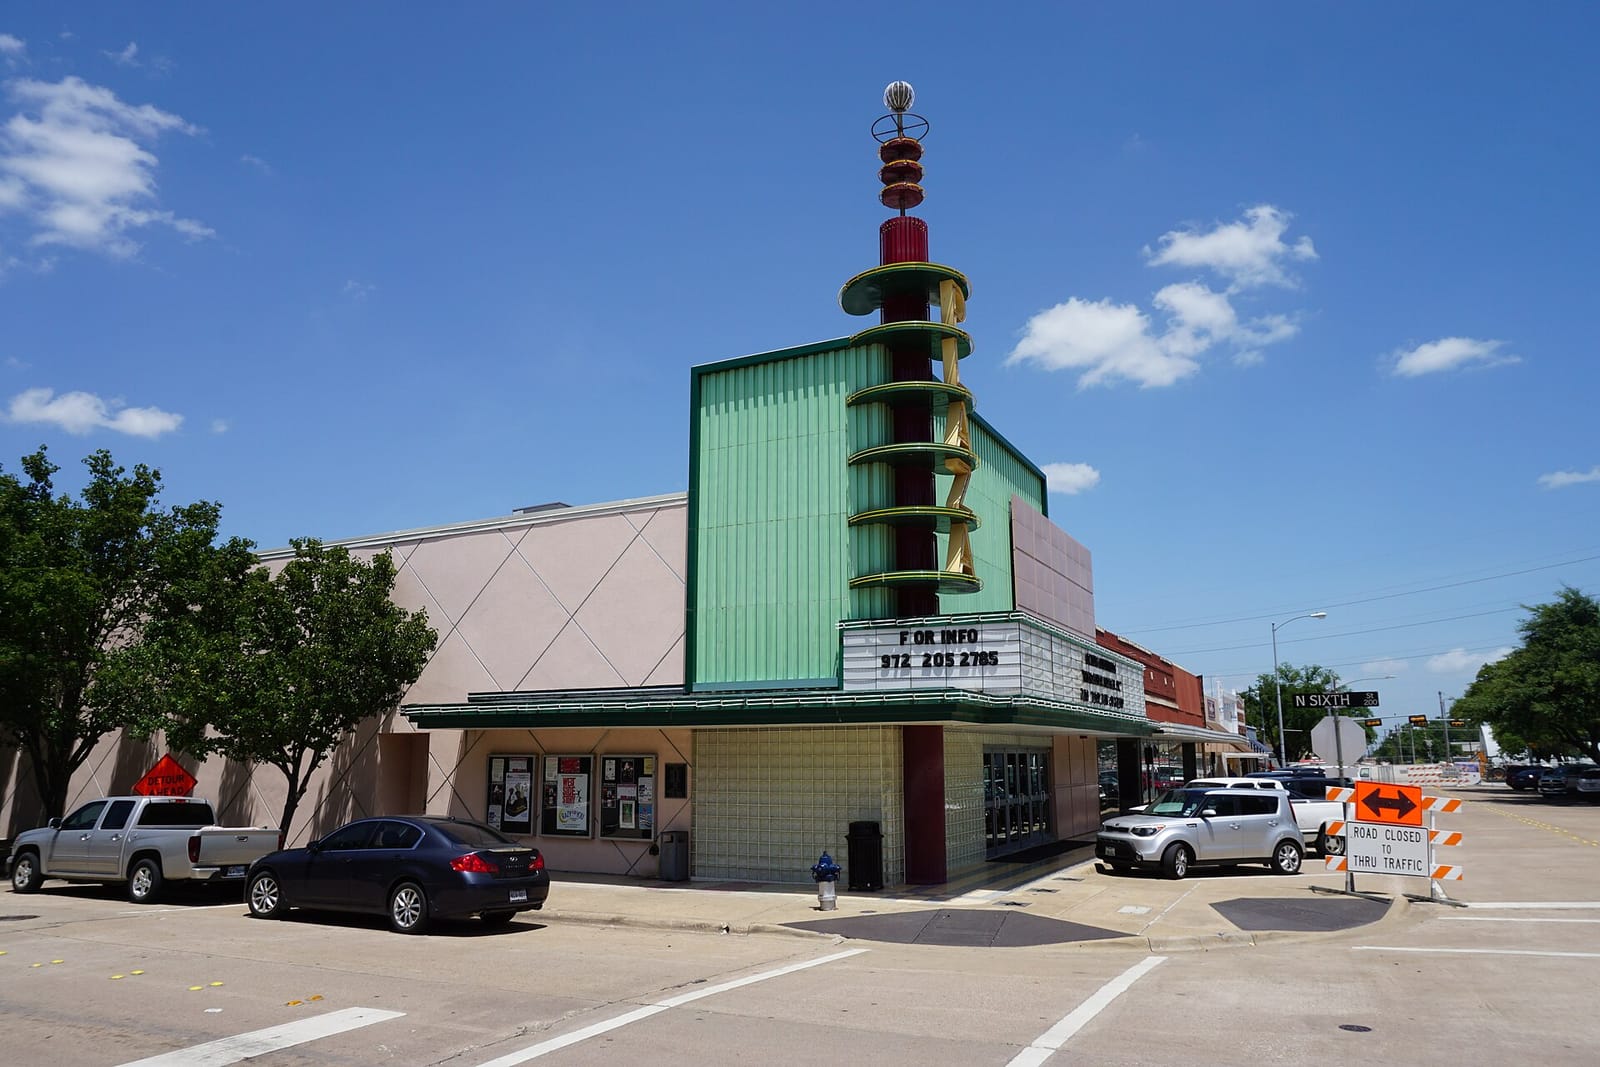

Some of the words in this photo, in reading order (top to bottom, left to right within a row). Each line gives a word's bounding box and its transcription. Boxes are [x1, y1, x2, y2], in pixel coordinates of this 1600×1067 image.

[941, 628, 978, 644] INFO
[881, 654, 911, 668] 972
[922, 653, 955, 667] 205
[960, 651, 999, 666] 2785
[1295, 695, 1305, 706] N
[1309, 694, 1350, 706] SIXTH
[147, 775, 184, 785] DETOUR
[1353, 827, 1378, 840] ROAD
[1385, 829, 1421, 843] CLOSED
[1382, 844, 1392, 854] TO
[1353, 855, 1377, 867] THRU
[1384, 857, 1423, 871] TRAFFIC
